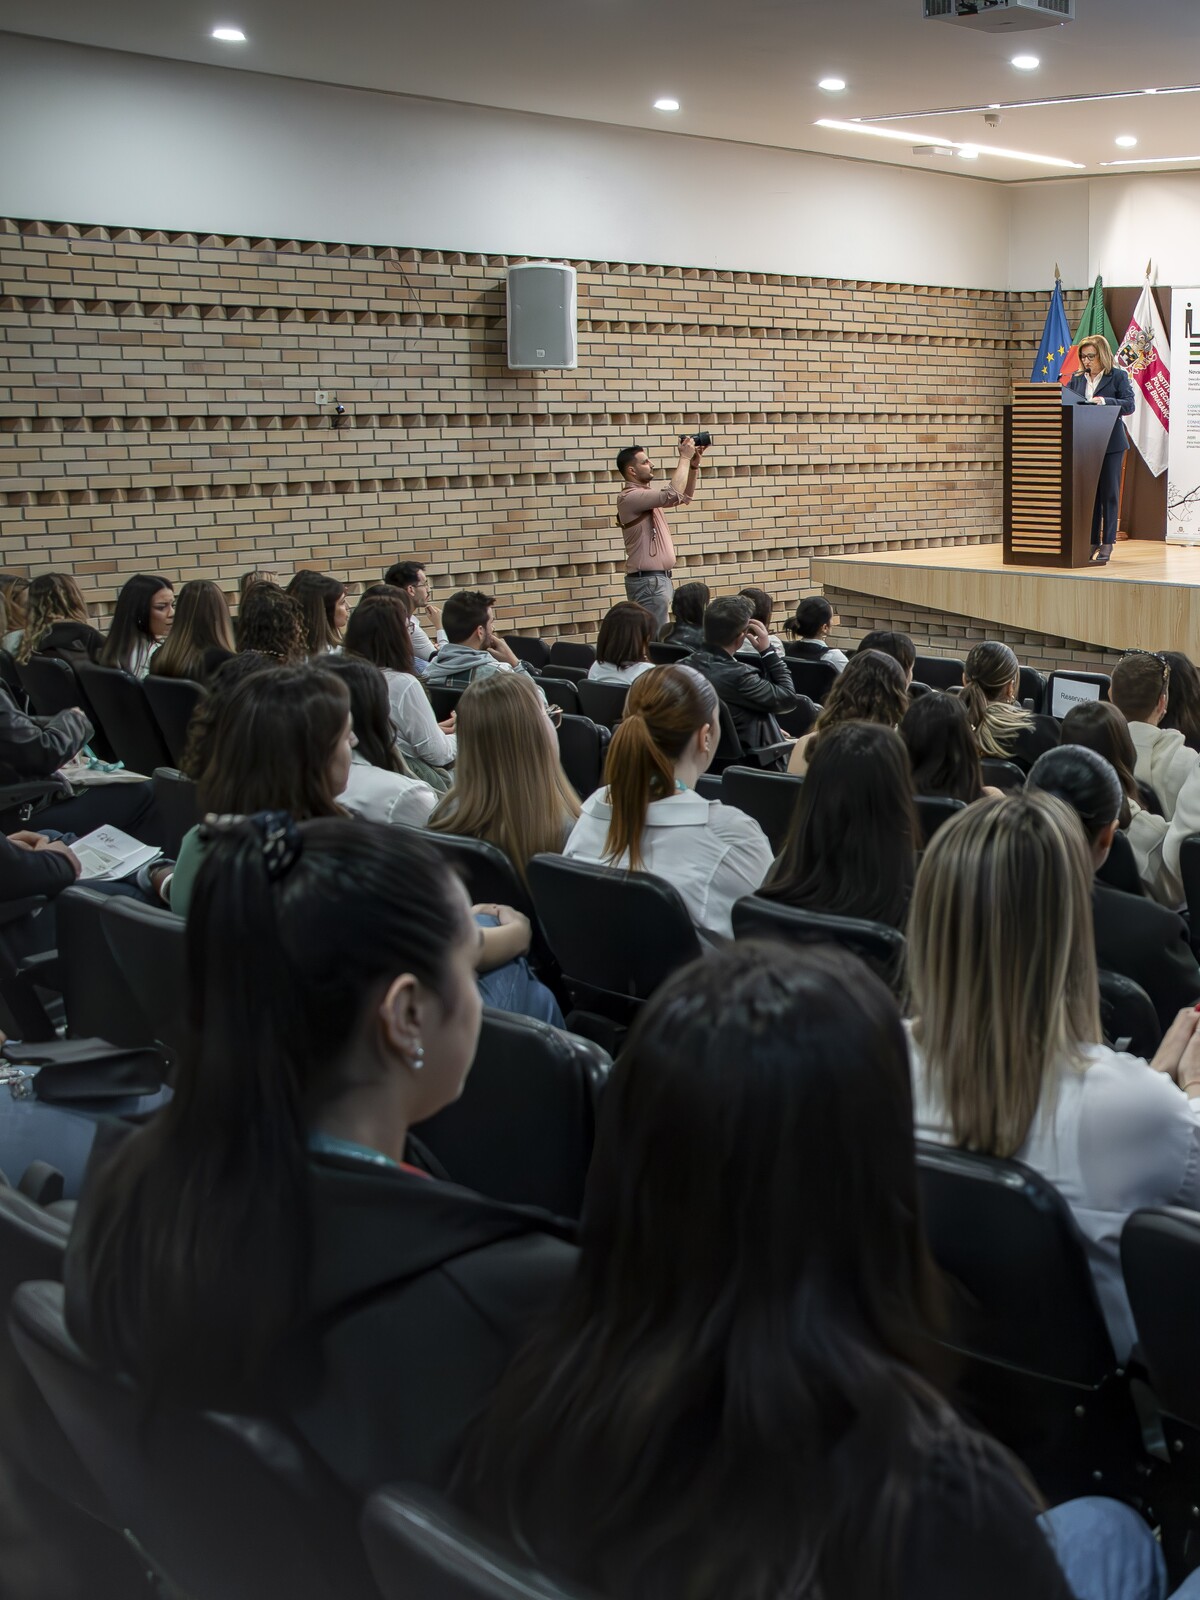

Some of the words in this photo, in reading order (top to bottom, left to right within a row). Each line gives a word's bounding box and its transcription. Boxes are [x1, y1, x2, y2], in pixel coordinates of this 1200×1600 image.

[1144, 381, 1154, 392] DE
[1150, 390, 1170, 420] BRAGANÇ
[1060, 692, 1092, 703] Reserva
